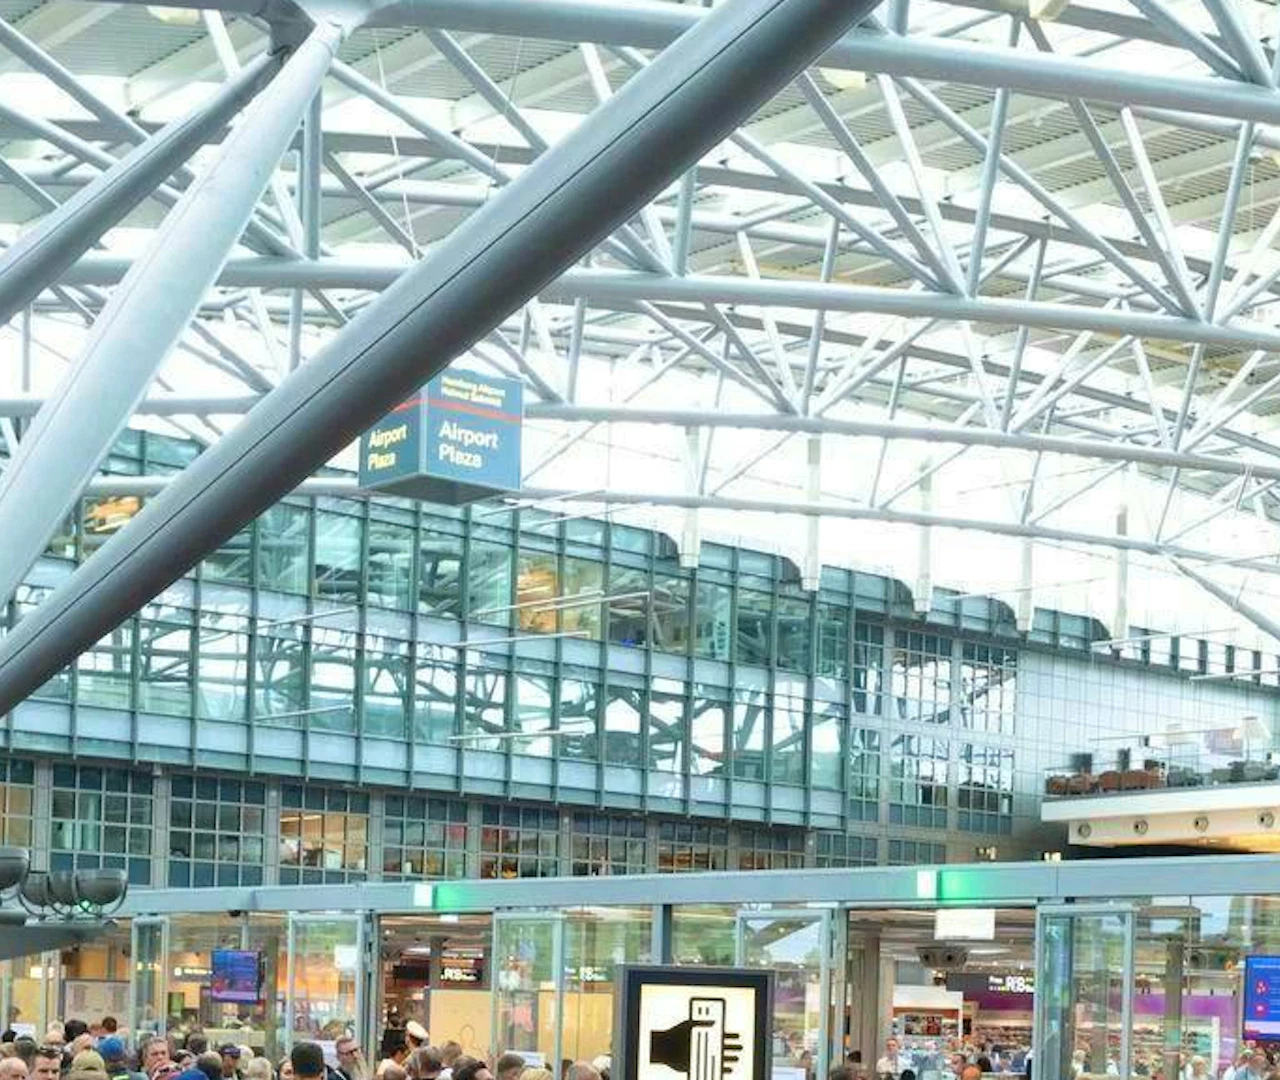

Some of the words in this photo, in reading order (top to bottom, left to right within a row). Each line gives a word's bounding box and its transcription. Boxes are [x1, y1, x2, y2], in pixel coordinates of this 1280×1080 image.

[368, 424, 408, 449] Airport
[438, 421, 498, 449] Airport
[367, 452, 396, 471] Plaza
[438, 443, 482, 468] Plaza
